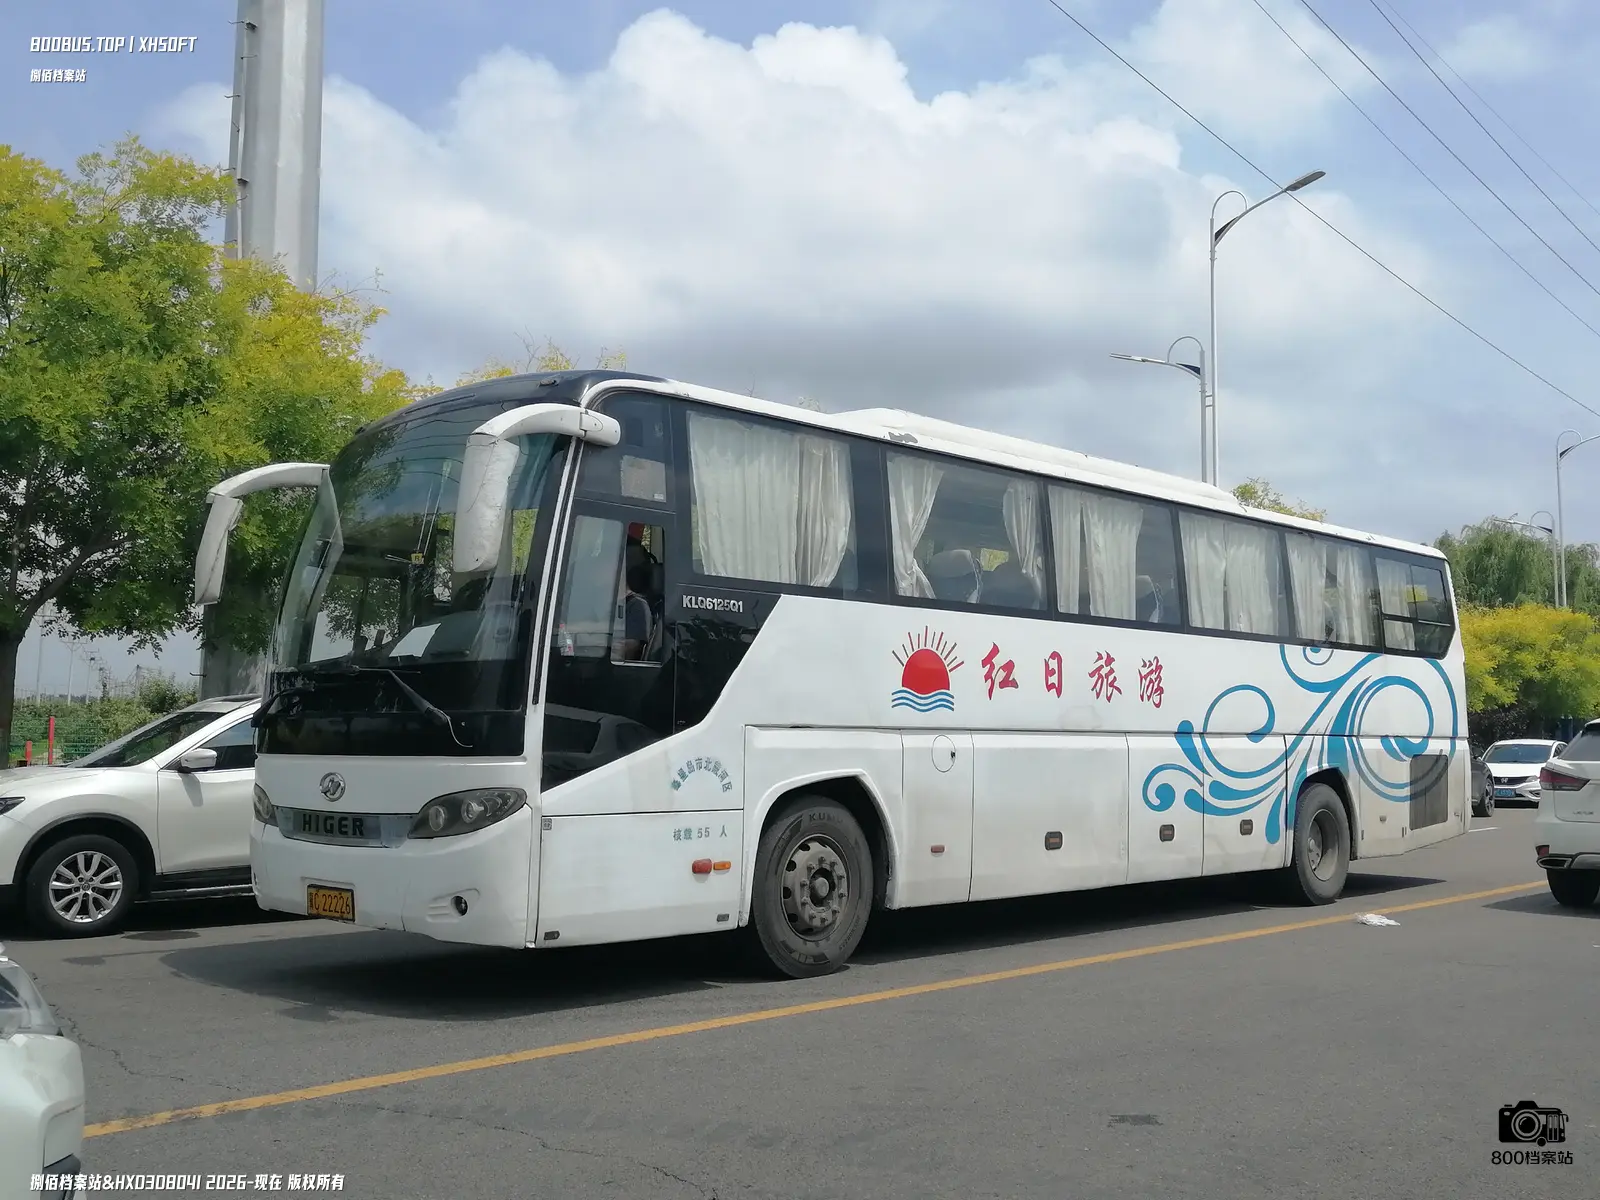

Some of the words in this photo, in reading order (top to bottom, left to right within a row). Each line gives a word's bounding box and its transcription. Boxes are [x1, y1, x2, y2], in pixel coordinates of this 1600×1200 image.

[682, 594, 744, 613] KLQ6125Q1
[981, 641, 1165, 709] 红日旅游
[302, 813, 365, 837] HIGER
